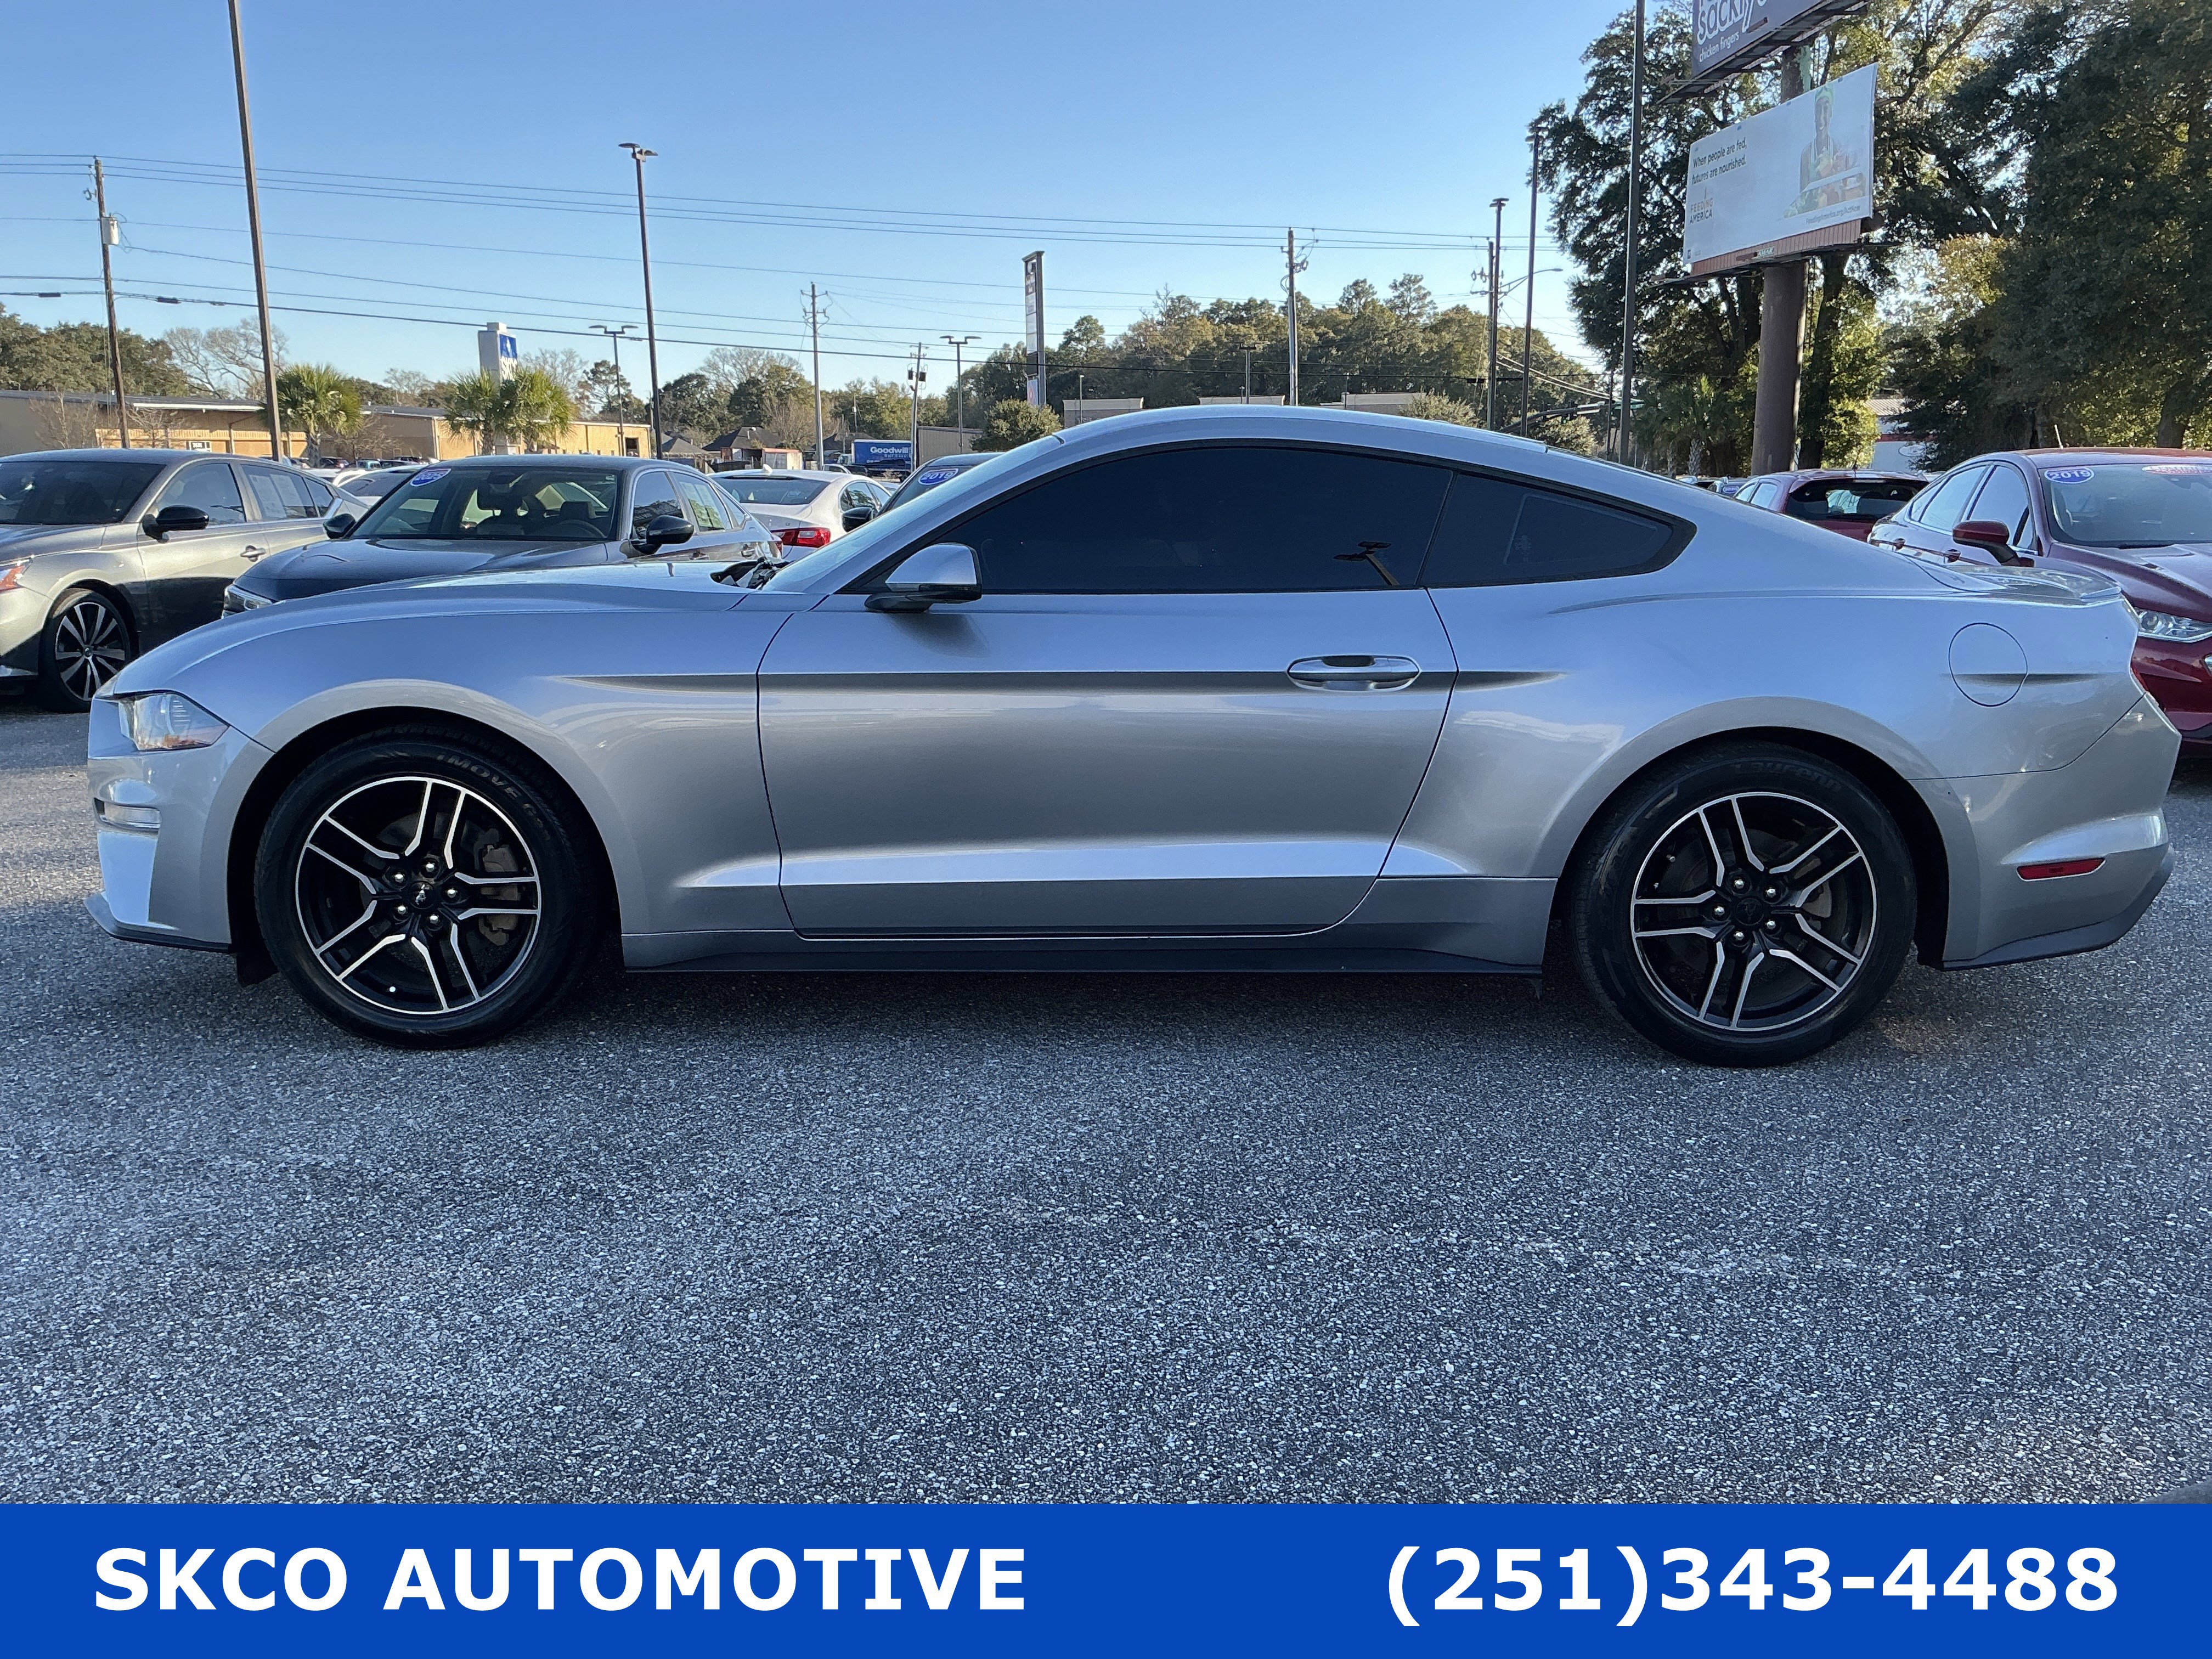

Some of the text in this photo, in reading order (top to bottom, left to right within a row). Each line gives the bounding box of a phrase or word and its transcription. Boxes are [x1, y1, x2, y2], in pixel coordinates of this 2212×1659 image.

[1699, 31, 1740, 63] chicken fingers
[1693, 156, 1707, 169] When
[1707, 146, 1725, 165] people
[1726, 144, 1735, 155] are
[1691, 174, 1709, 185] futures
[1709, 167, 1718, 178] are
[1690, 197, 1714, 213] FEEDING
[1689, 208, 1713, 225] AMERICA
[921, 472, 953, 481] 2019
[2049, 470, 2091, 479] 2019
